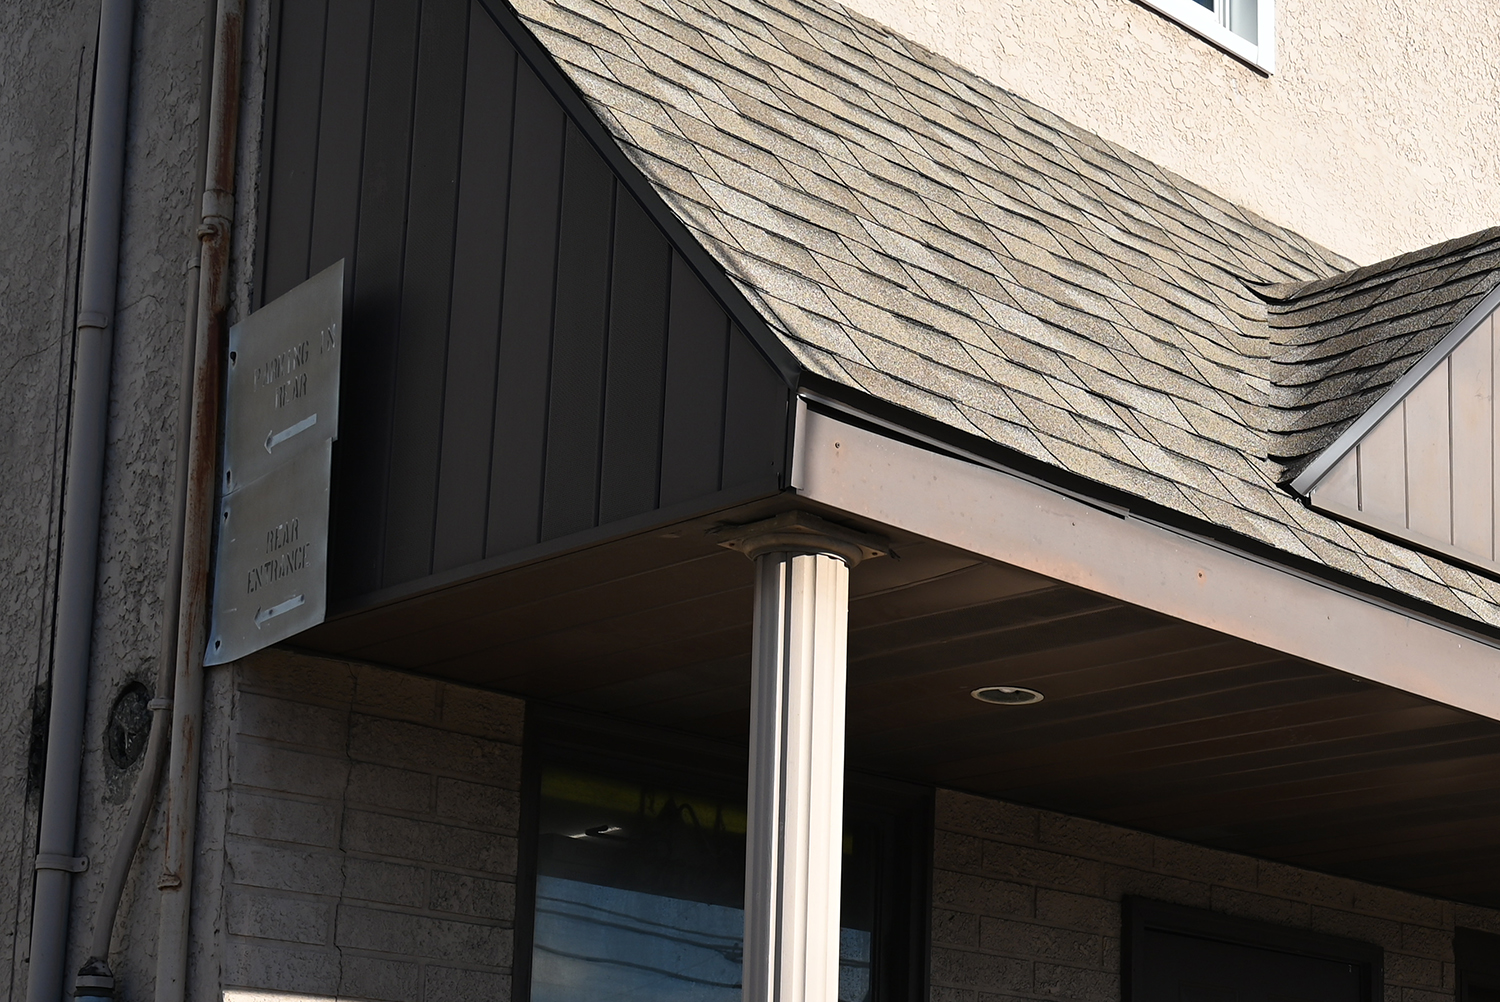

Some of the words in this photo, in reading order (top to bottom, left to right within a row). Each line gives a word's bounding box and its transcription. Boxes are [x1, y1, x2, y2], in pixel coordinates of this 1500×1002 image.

[253, 340, 309, 393] PARKING
[274, 372, 308, 410] REAR
[265, 517, 299, 555] REAR
[246, 542, 311, 595] ENTRANCE
